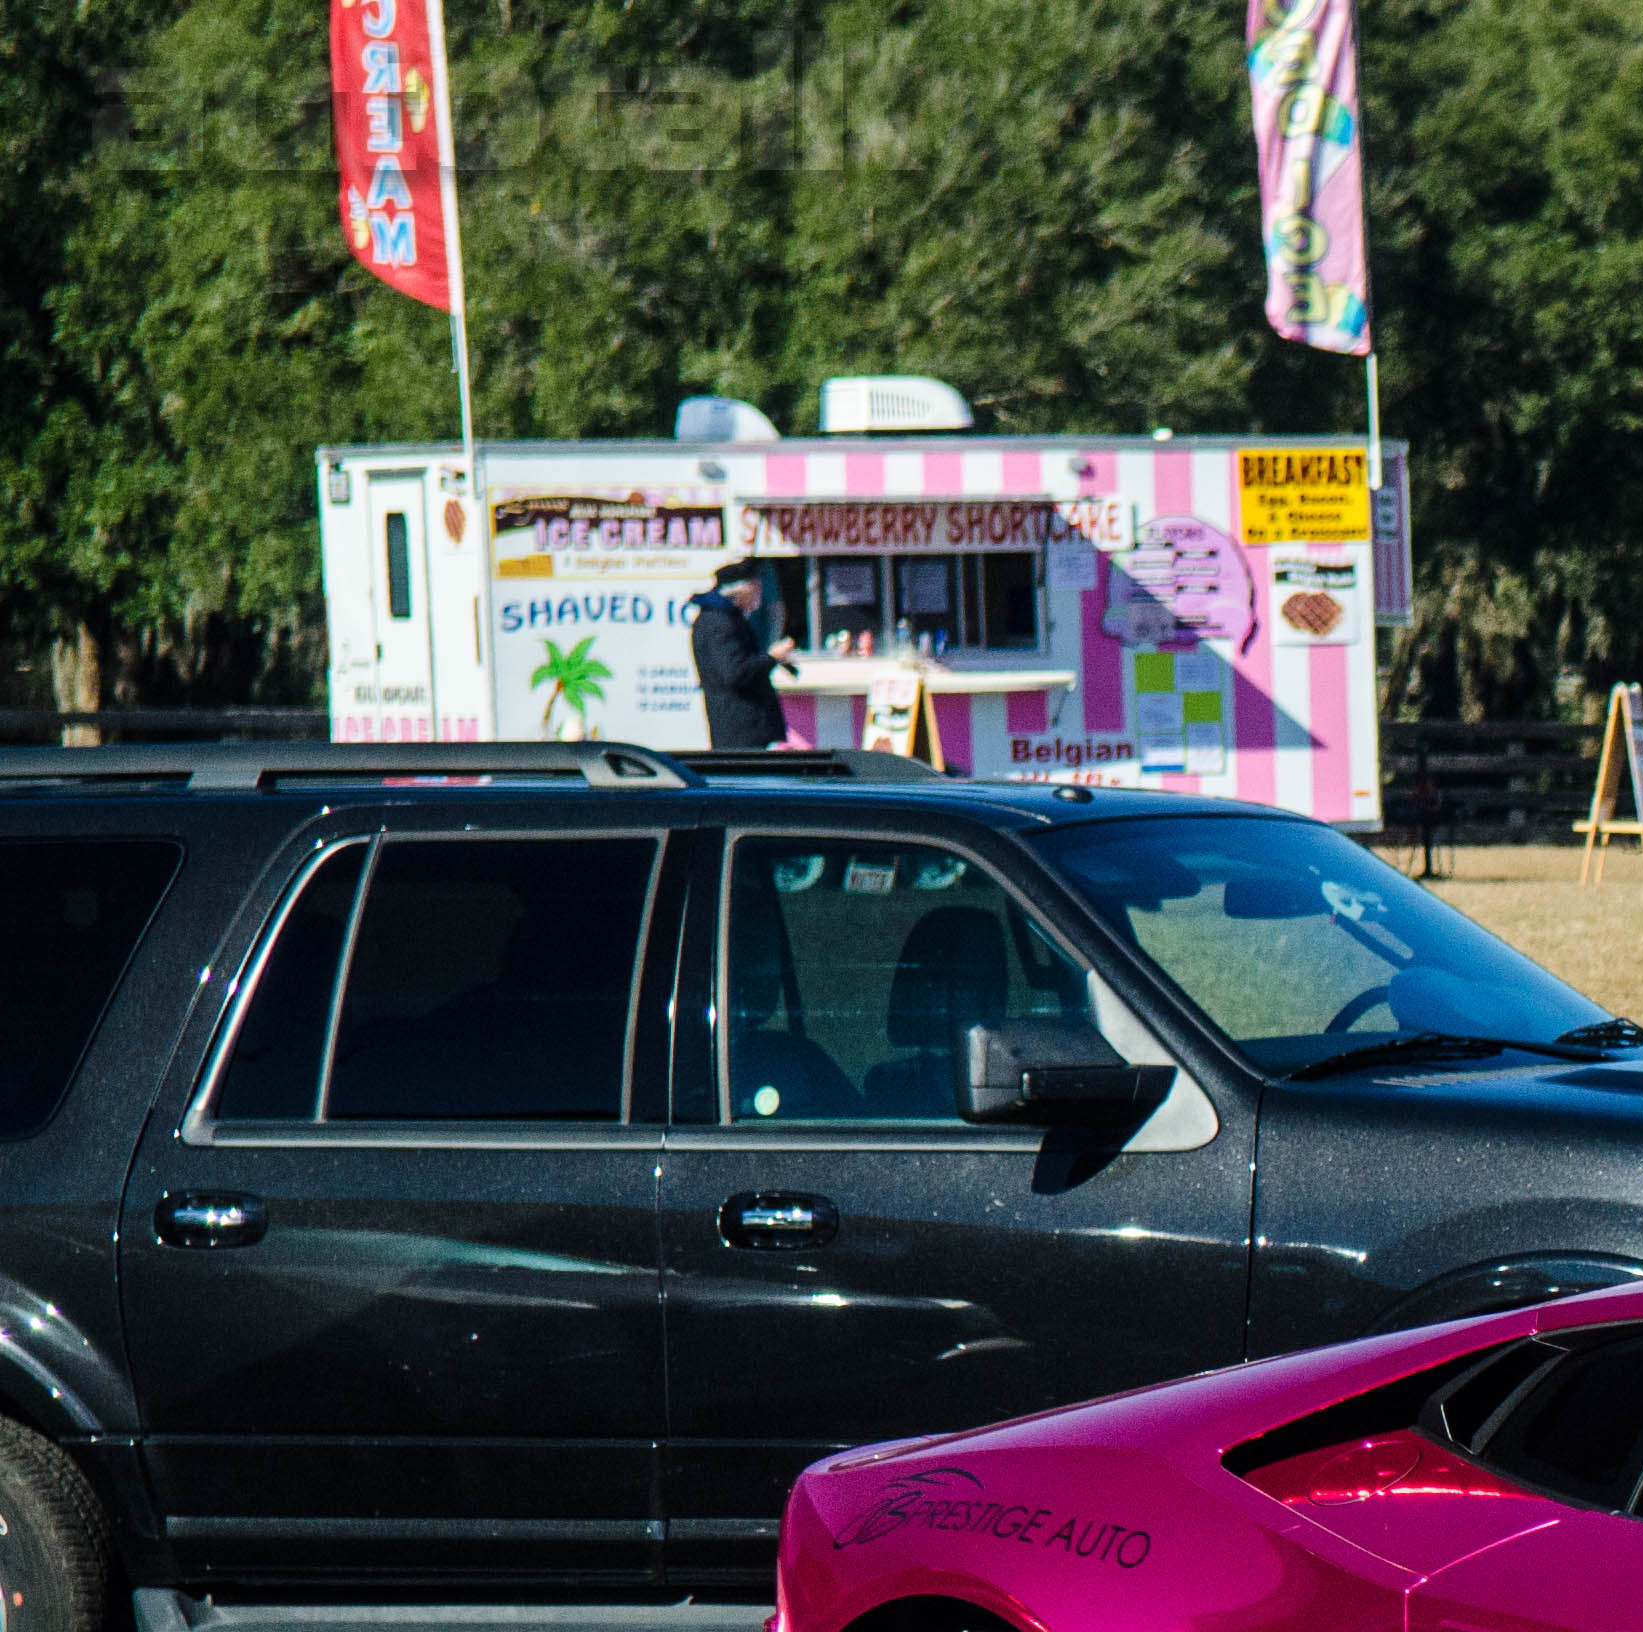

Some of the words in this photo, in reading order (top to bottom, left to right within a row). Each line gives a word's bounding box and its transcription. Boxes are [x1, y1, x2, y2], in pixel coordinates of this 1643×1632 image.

[1242, 455, 1363, 487] BREAKFAST
[533, 516, 592, 550] ICE
[599, 516, 723, 549] CREAM
[740, 502, 937, 547] STRAWBERRY
[946, 501, 1123, 546] SHORTCAKE
[502, 592, 655, 633] SHAVED
[667, 598, 700, 627] IC
[1011, 737, 1133, 767] Belgian
[910, 1500, 1052, 1544] PRESTIGE
[1045, 1517, 1151, 1569] AUTO
